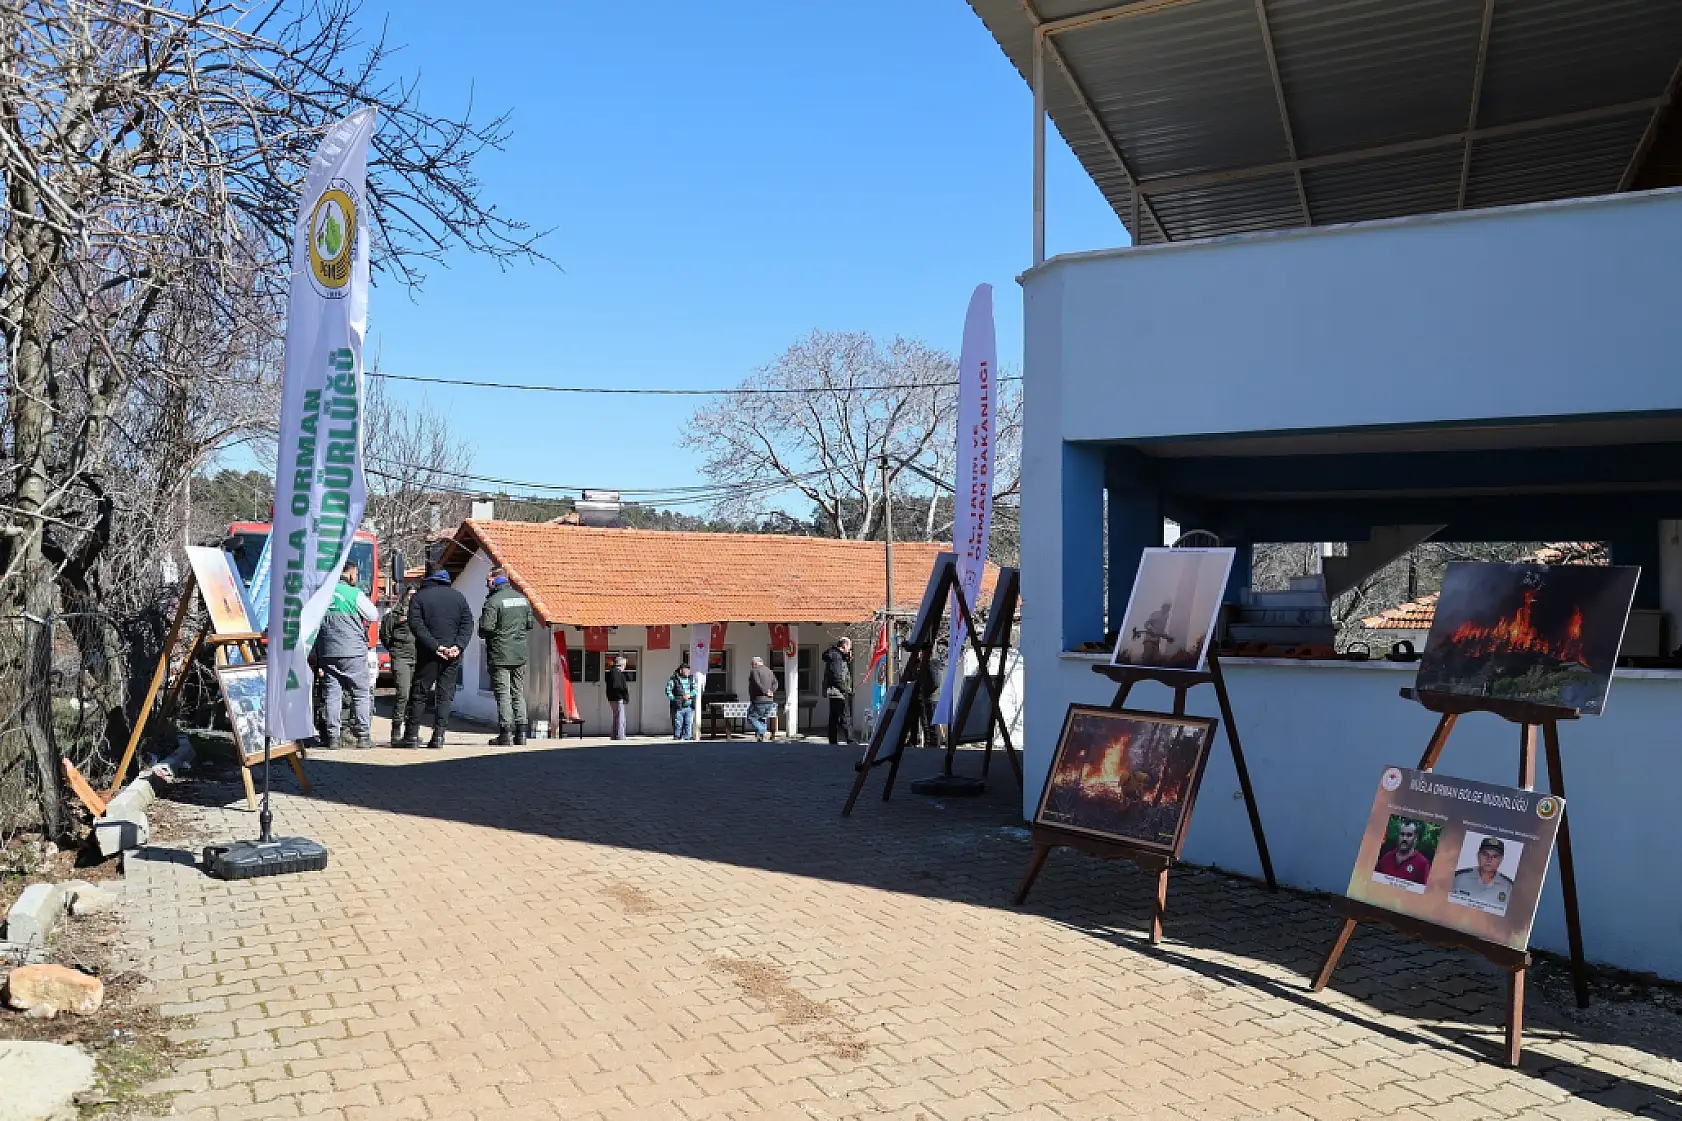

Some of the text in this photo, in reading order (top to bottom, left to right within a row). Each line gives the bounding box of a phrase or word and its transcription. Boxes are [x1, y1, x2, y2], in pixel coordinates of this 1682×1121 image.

[291, 388, 322, 517] ORMAN
[313, 347, 359, 573] MÜDÜRLÜĞÜ
[975, 483, 987, 561] ORMAN
[283, 528, 307, 651] MUĞLA
[1433, 783, 1458, 798] ORMAN
[1458, 787, 1483, 803] BÖLGE
